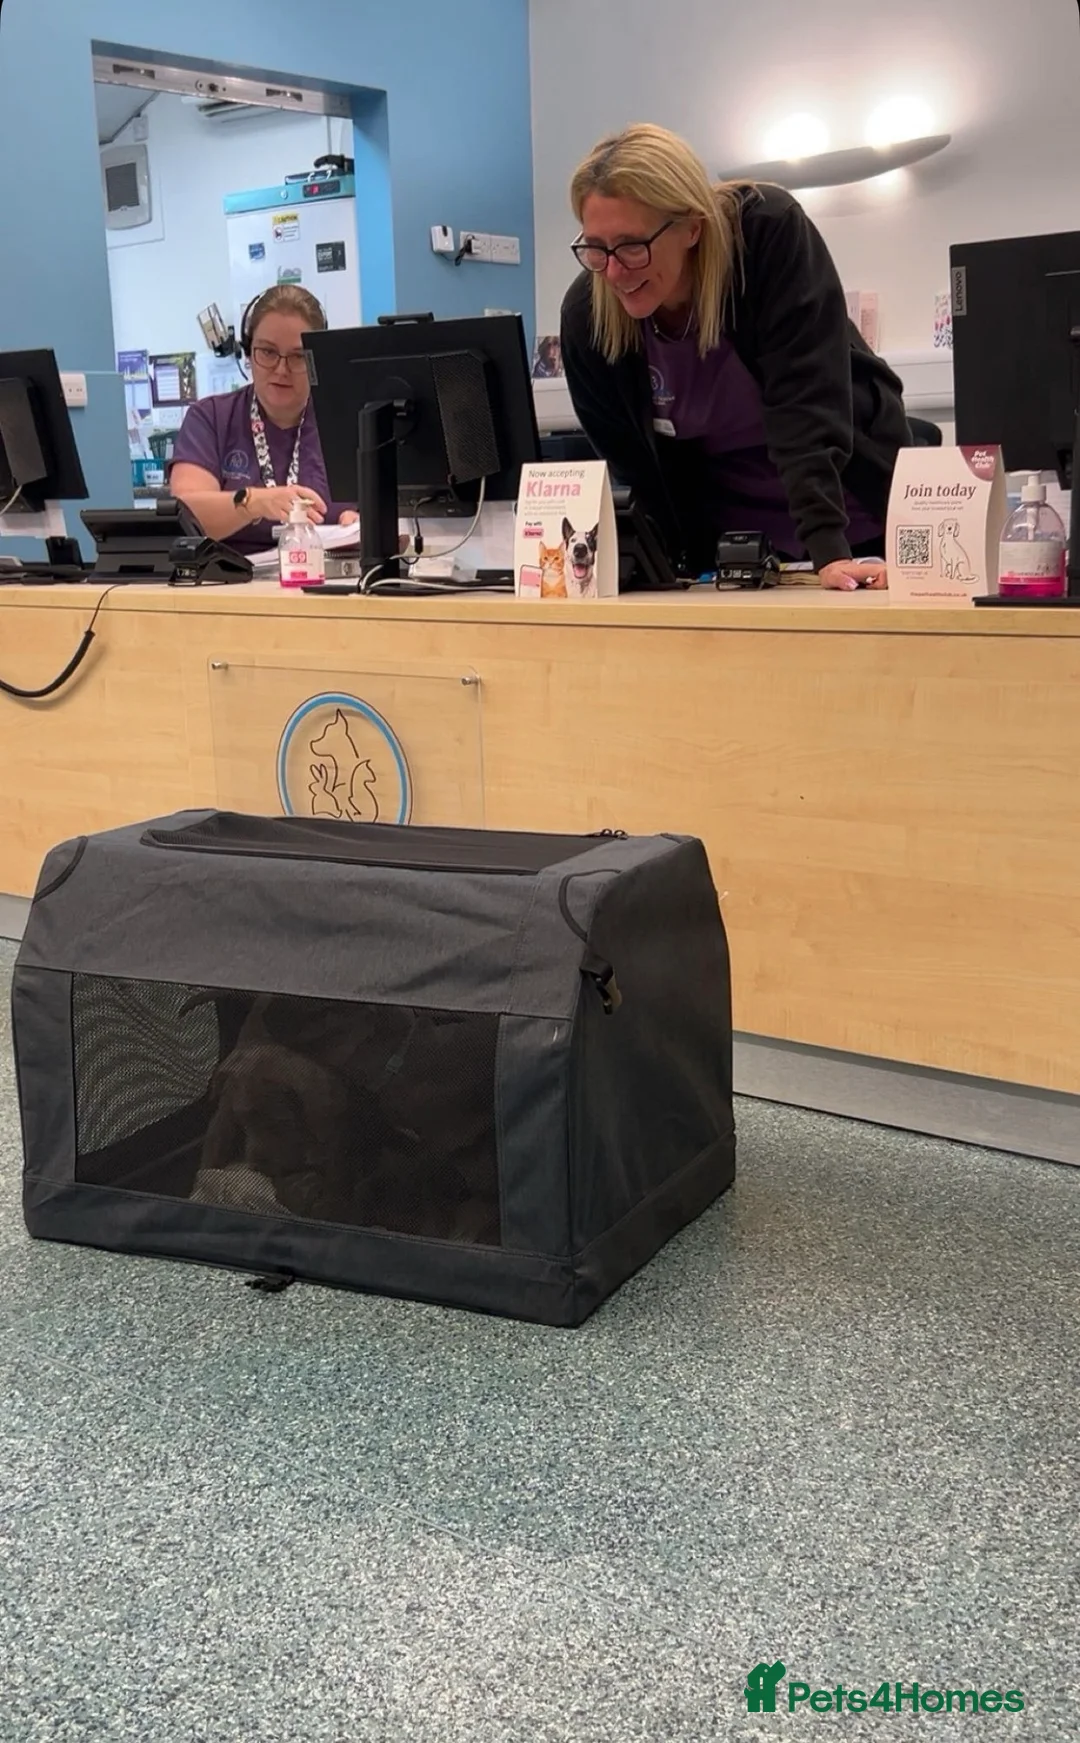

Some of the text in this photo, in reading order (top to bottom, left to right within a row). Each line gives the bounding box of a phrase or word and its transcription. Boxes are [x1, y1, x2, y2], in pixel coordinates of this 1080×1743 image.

[955, 271, 963, 312] Lenovo
[528, 469, 585, 479] Now accepting
[526, 480, 581, 497] Klarna
[904, 483, 977, 500] Join today
[290, 552, 306, 563] G9
